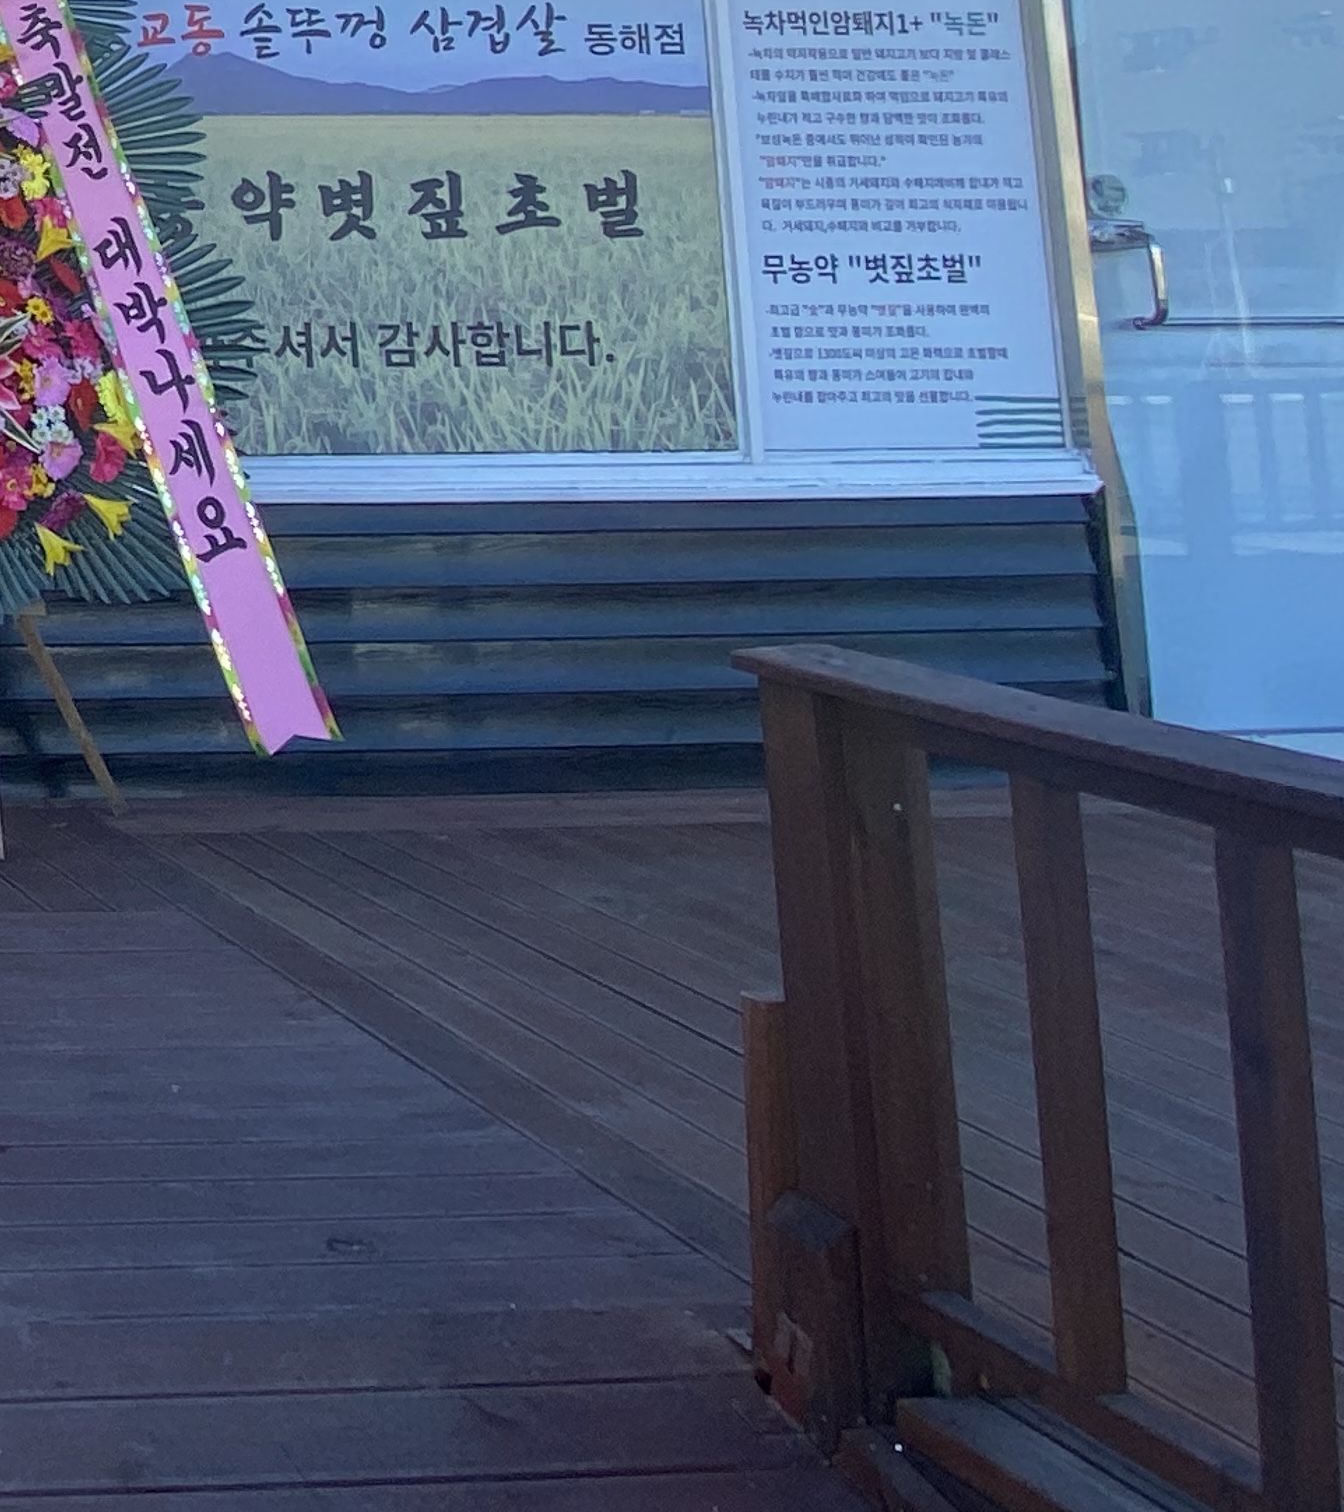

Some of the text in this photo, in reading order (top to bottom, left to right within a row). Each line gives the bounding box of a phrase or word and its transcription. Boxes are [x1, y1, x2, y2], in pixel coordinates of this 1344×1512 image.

[136, 2, 687, 59] 교동 솥뚜껑 삼겹살 동해점
[848, 253, 981, 284] "볏짚초벌"
[378, 319, 616, 368] 감사합니다.
[92, 216, 249, 565] 대박나세요
